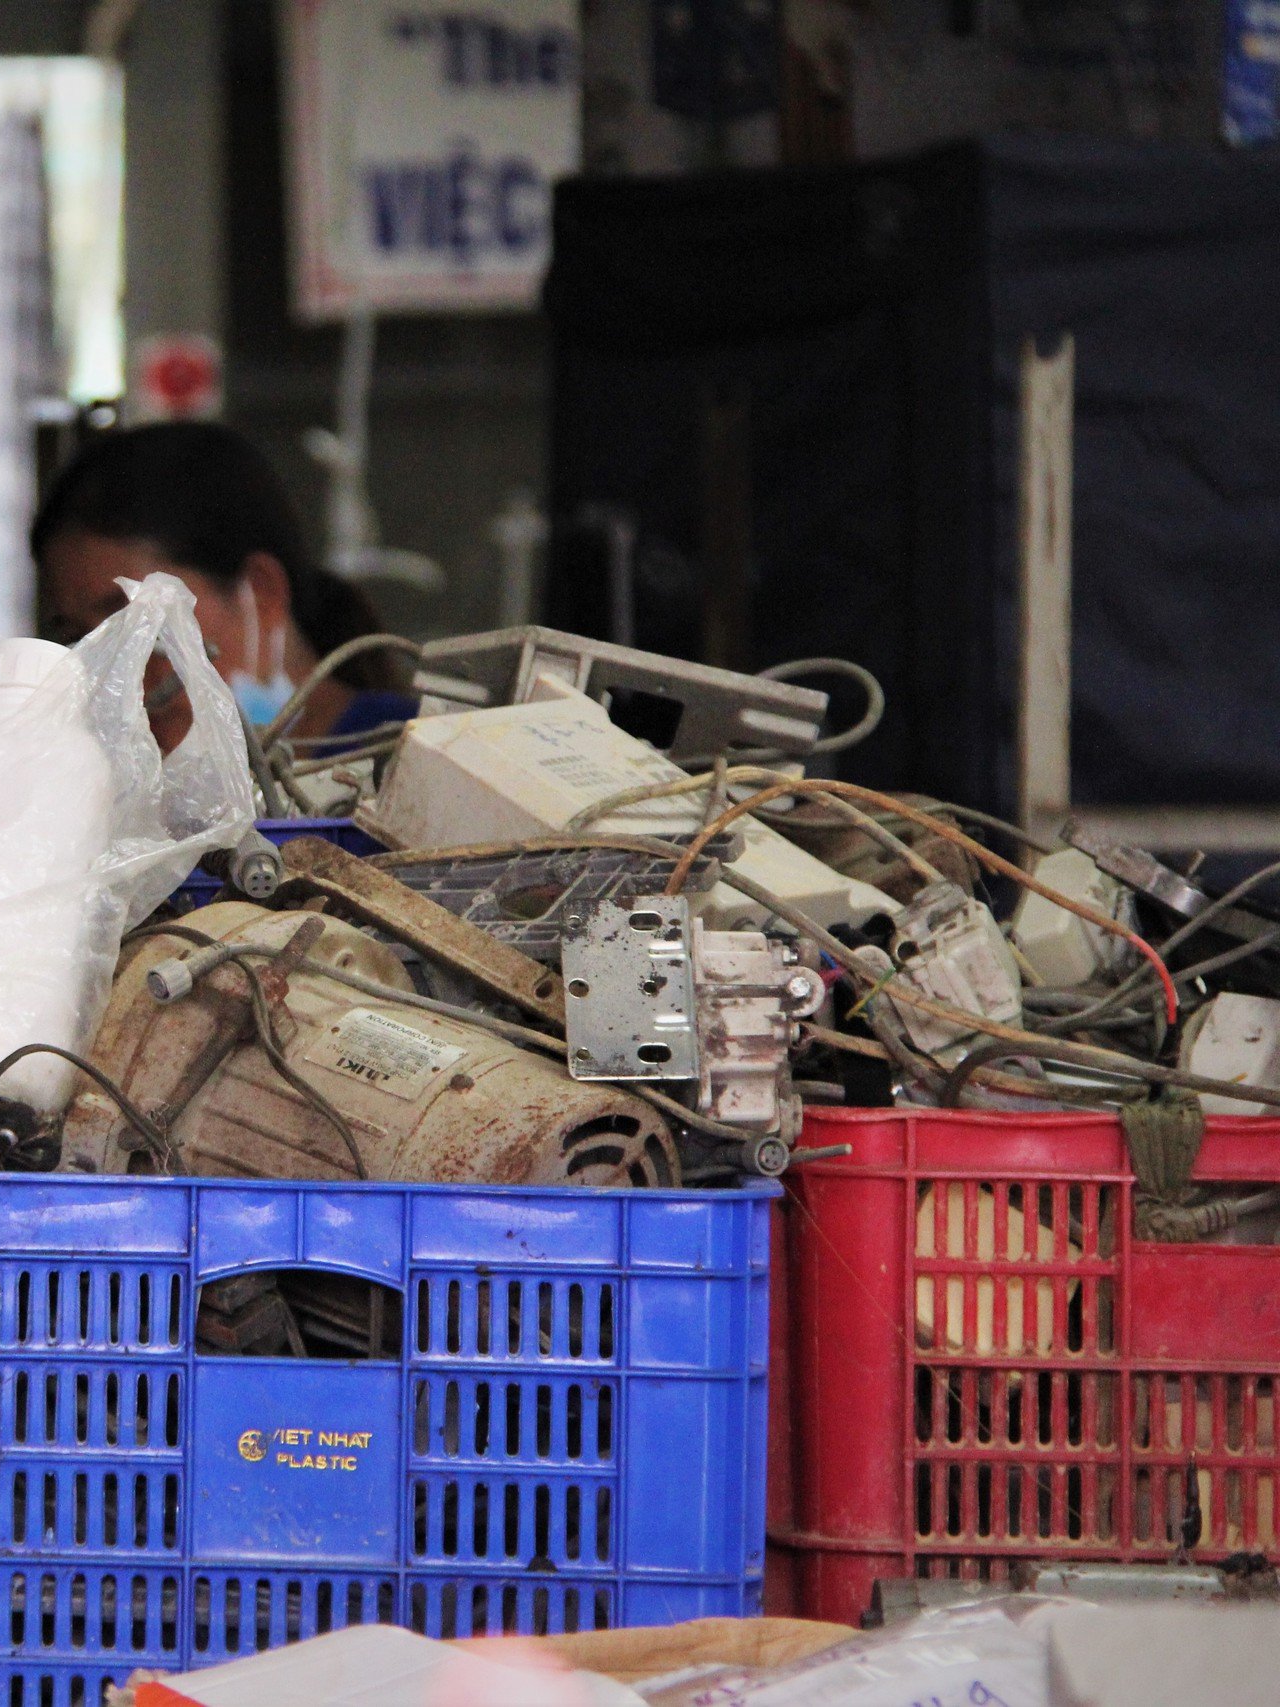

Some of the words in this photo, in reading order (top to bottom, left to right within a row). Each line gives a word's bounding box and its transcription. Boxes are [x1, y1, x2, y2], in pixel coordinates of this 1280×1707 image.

[335, 1056, 391, 1081] JUKI
[318, 1430, 373, 1449] NHAT
[276, 1451, 358, 1471] PLASTIC
